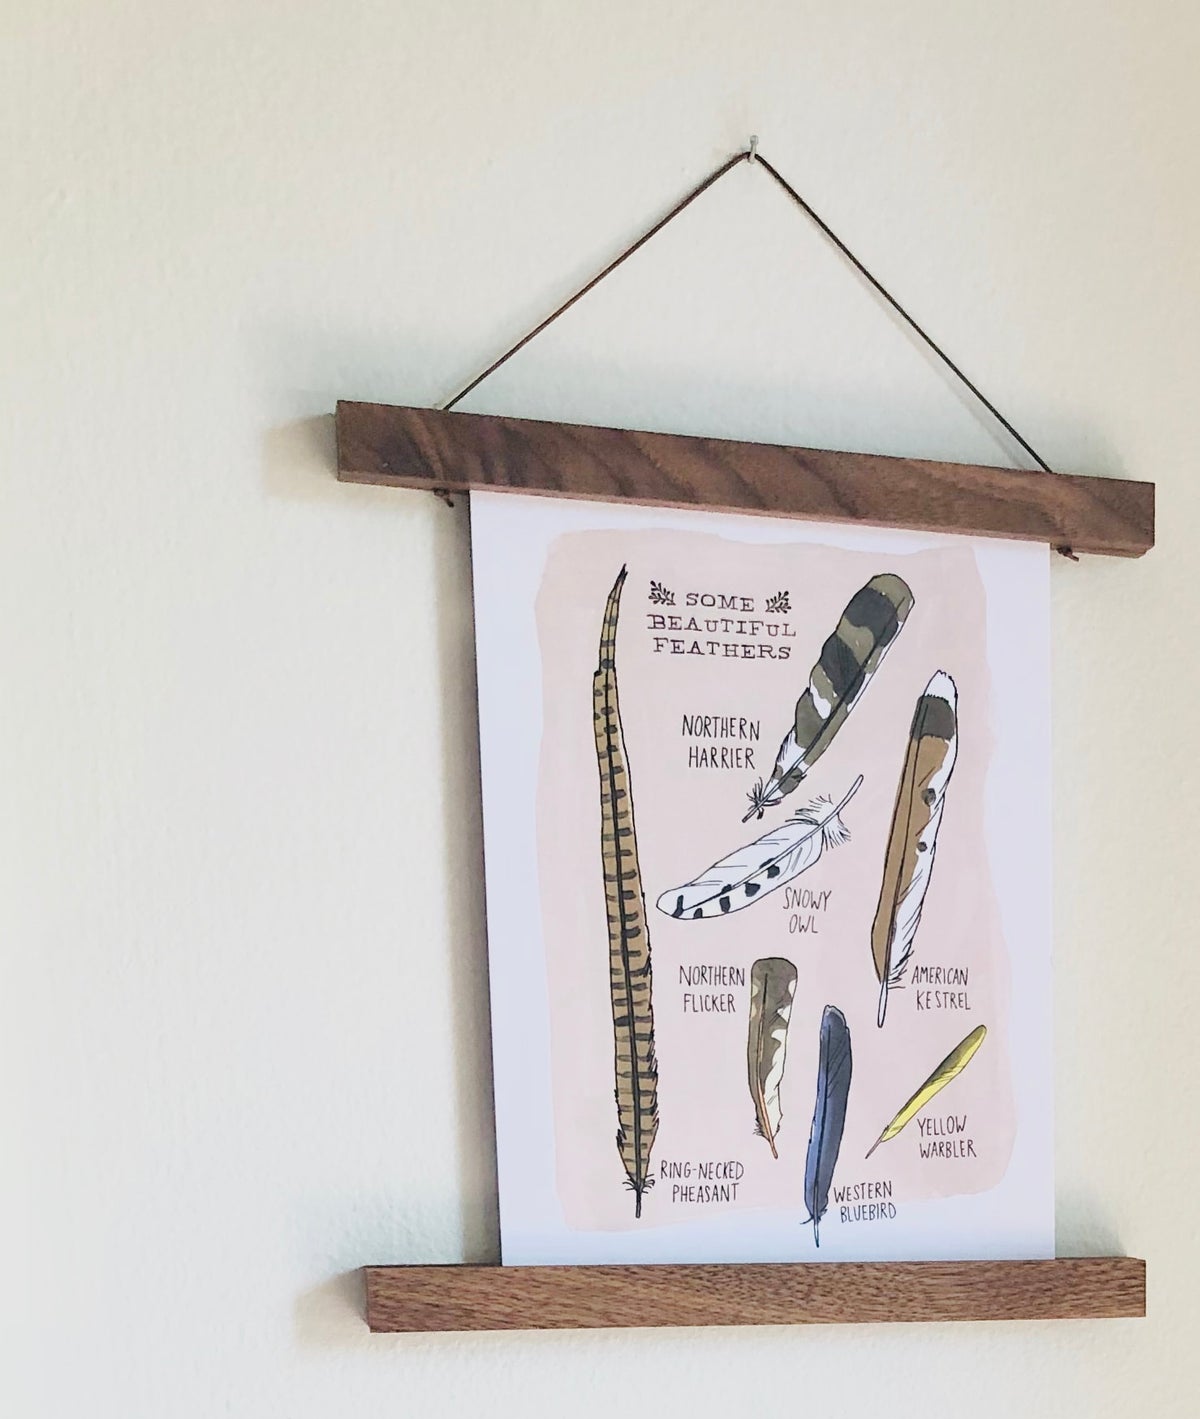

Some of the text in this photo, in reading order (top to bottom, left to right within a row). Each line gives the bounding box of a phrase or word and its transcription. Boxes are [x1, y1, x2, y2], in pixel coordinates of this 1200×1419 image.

[685, 592, 755, 613] SOME
[647, 613, 797, 638] BEAUTIFUL
[652, 637, 792, 660] FEATHERS
[682, 714, 760, 742] NORTHERN
[688, 746, 756, 770] HARRIER
[782, 887, 832, 912] SNOWY
[789, 915, 818, 934] OWL
[679, 965, 745, 987] NORTHERN
[911, 966, 968, 986] AMERICAN
[683, 994, 736, 1013] FLICKER
[916, 991, 971, 1011] KESTREL
[917, 1115, 967, 1138] YELLOW
[919, 1139, 977, 1159] WARBLER
[661, 1160, 744, 1181] RING-NECKED
[672, 1183, 740, 1203] PHEASANT
[833, 1181, 892, 1203] WESTERN
[840, 1202, 897, 1223] BLUEBIRD
